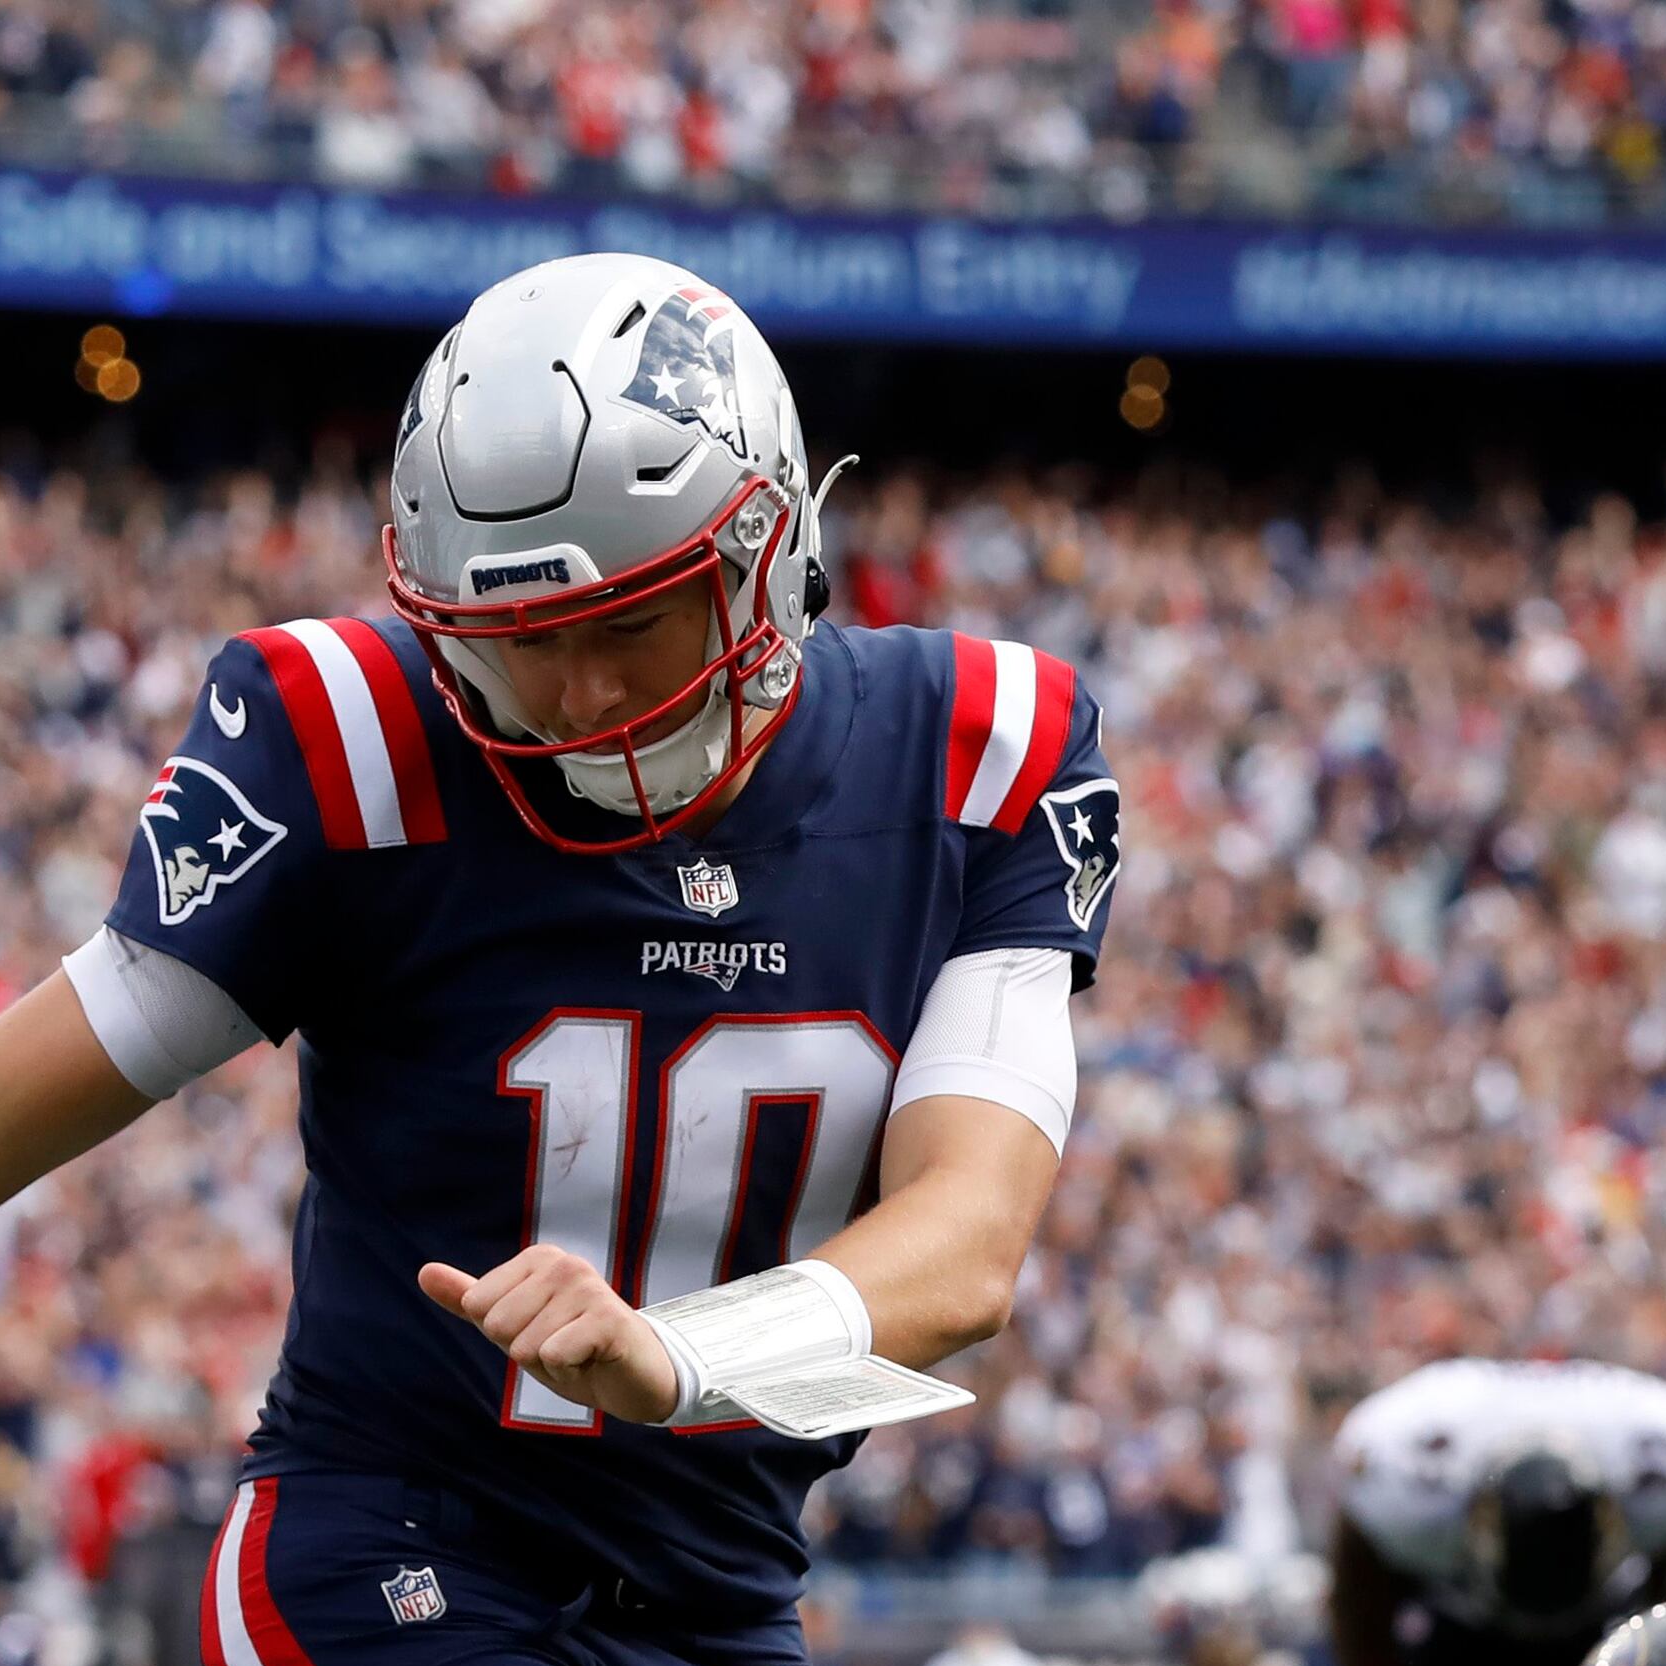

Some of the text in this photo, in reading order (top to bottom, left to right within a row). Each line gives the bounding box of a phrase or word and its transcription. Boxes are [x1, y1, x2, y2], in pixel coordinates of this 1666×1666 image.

[161, 189, 315, 283] and
[919, 220, 1141, 332] Entry
[471, 557, 570, 595] PATRIOTS
[691, 882, 728, 904] NFL
[641, 940, 786, 975] PATRIOTS
[496, 1006, 900, 1436] 10
[398, 1590, 438, 1619] NFL
